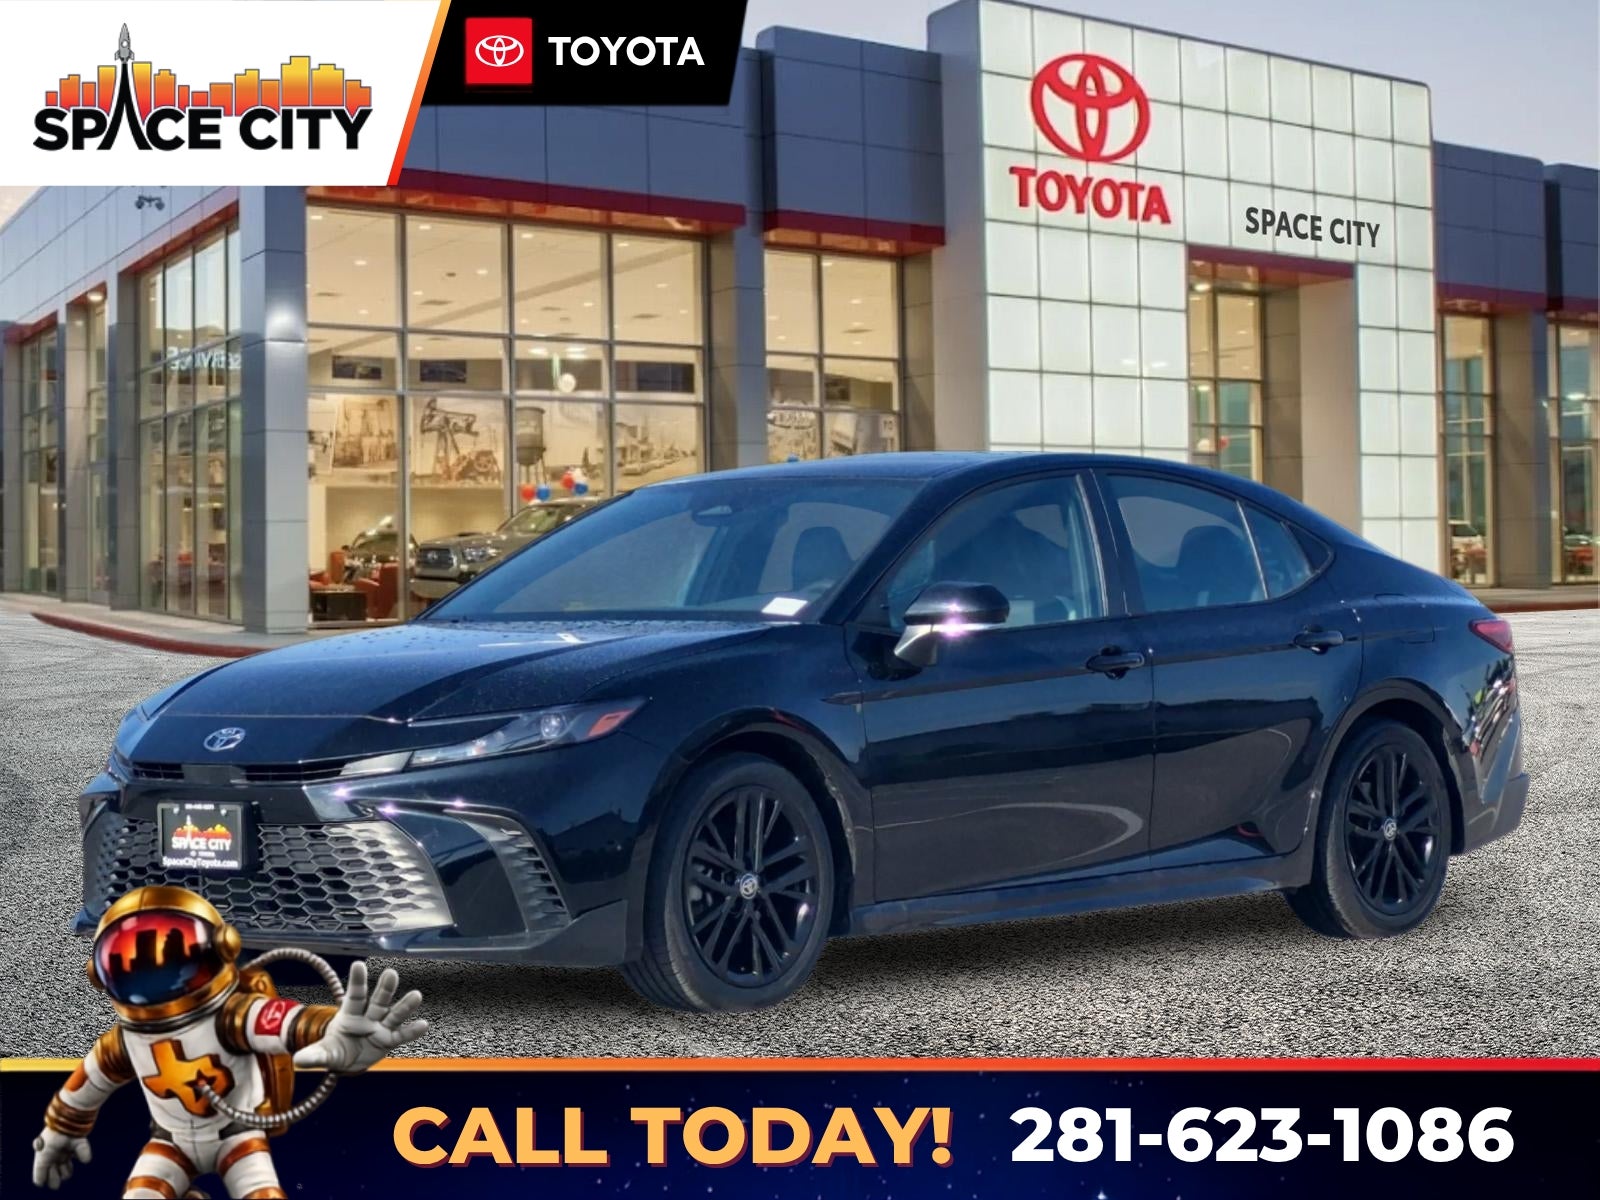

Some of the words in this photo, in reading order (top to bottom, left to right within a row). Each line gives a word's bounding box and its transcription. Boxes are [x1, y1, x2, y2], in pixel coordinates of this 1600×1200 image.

[1009, 166, 1171, 224] TOYOTA
[1245, 206, 1323, 242] SPACE
[1329, 218, 1381, 248] CITY
[171, 837, 207, 850] SPACE
[207, 838, 232, 851] CITY
